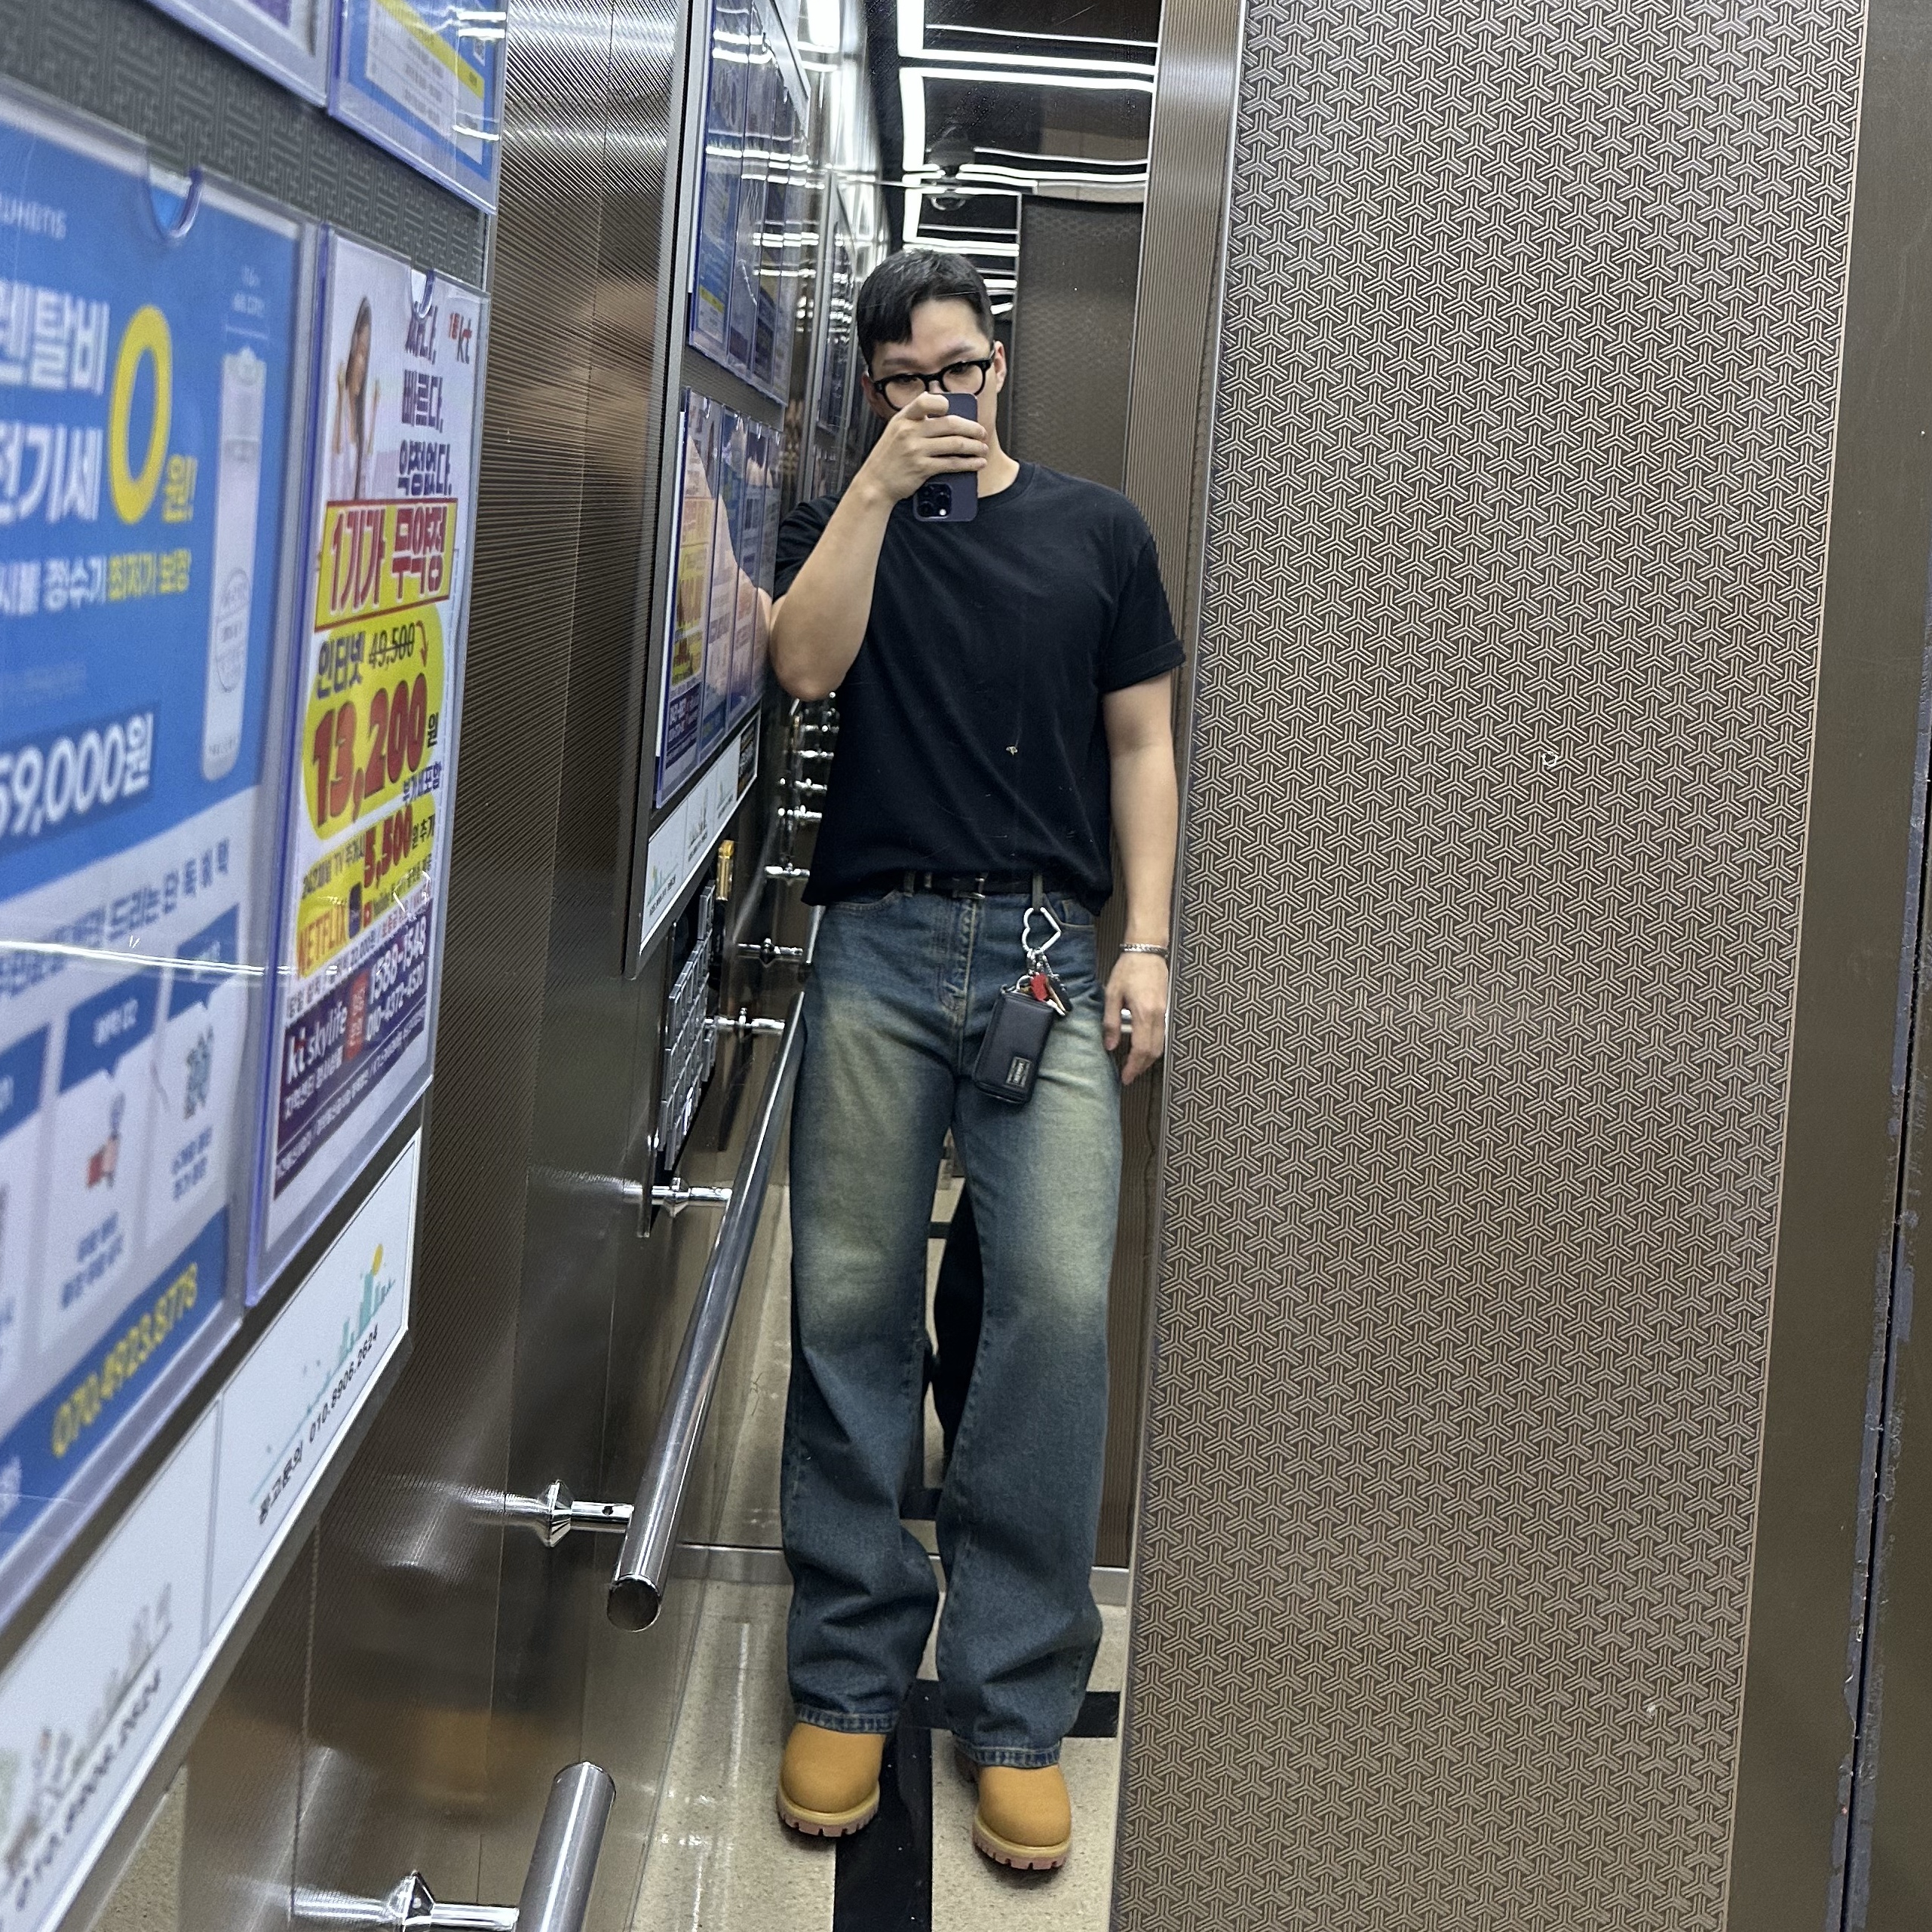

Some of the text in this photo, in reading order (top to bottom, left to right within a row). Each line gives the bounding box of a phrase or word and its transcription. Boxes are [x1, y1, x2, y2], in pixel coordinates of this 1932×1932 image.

[457, 315, 472, 364] kt
[330, 504, 449, 614] 1기가 무약정
[316, 622, 415, 700] 인터넷 49,500
[286, 1027, 306, 1085] kt
[306, 1000, 348, 1066] skylife
